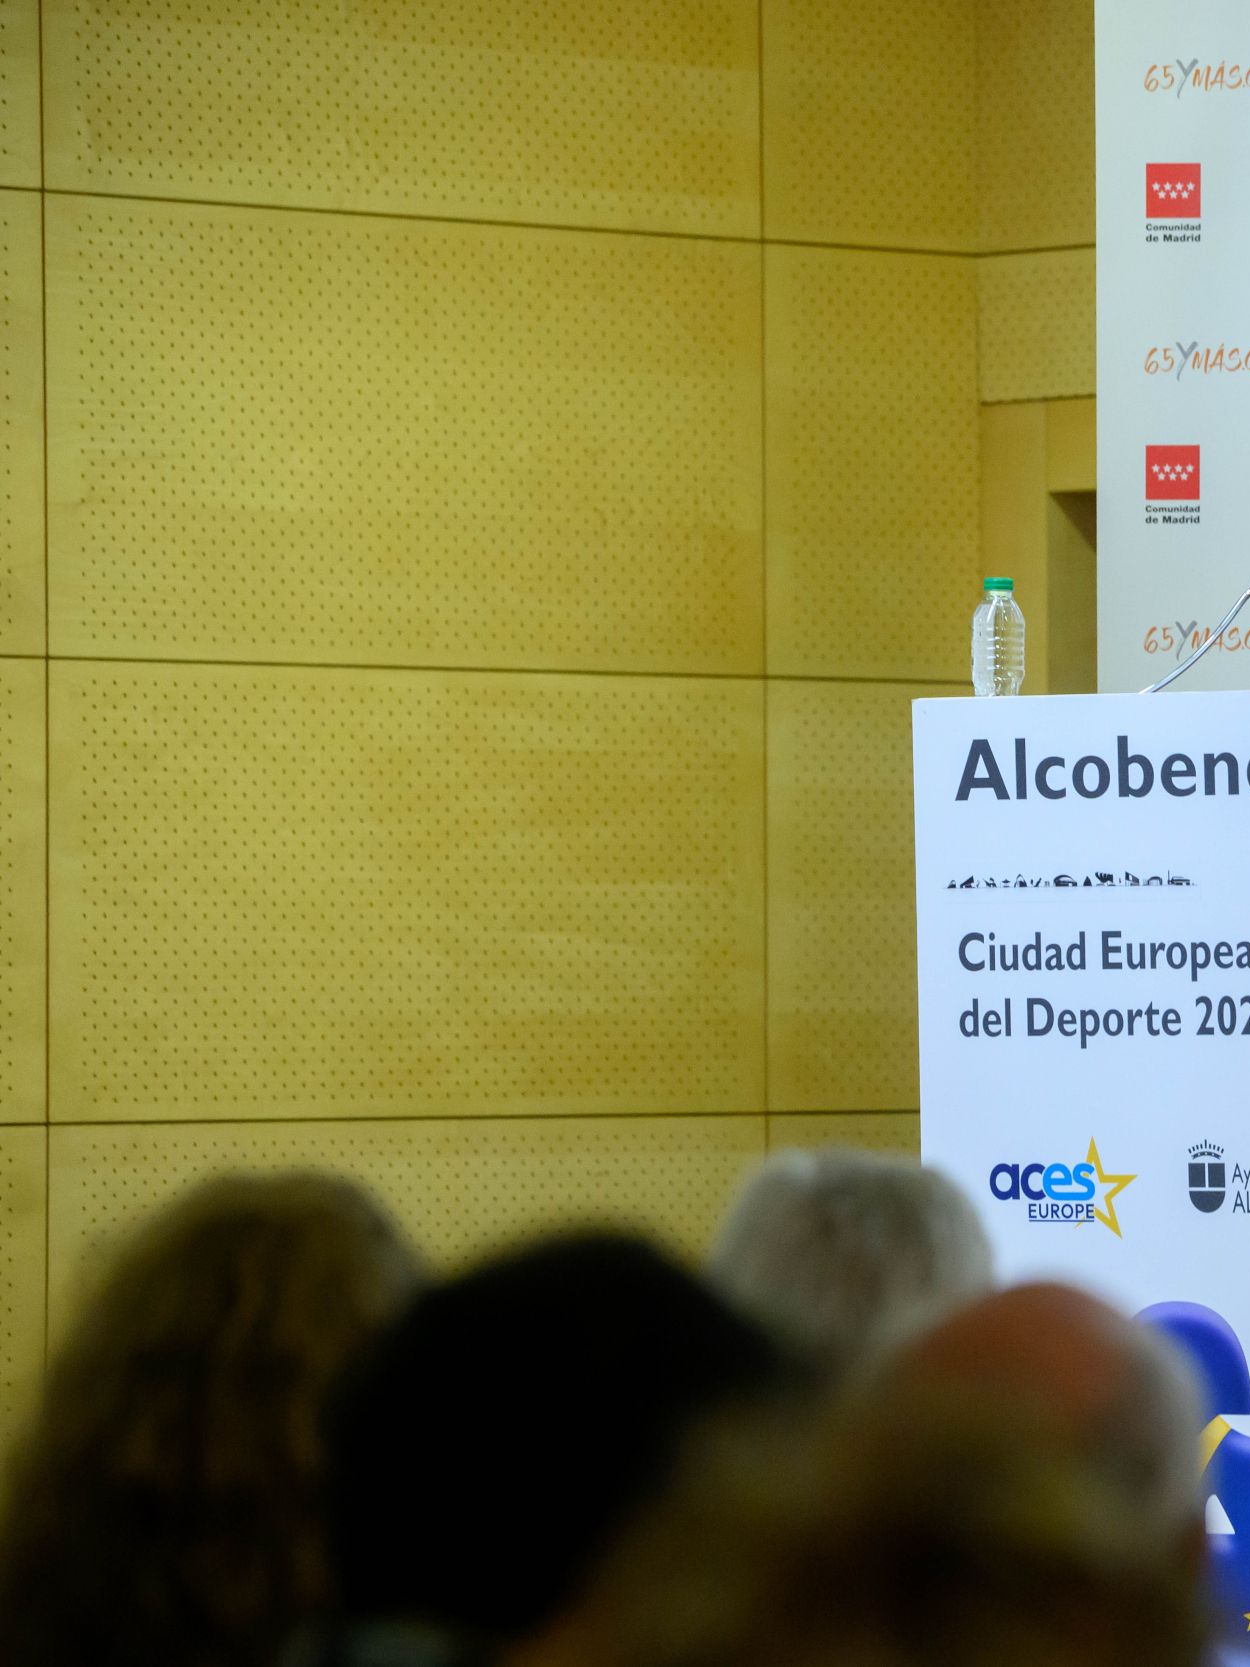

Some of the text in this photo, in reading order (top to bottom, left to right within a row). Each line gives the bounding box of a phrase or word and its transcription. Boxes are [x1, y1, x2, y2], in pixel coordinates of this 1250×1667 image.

[1145, 223, 1202, 232] Comunidad
[1145, 234, 1202, 243] de Madrid
[1145, 505, 1201, 513] Comunidad
[1145, 515, 1201, 524] de Madrid
[958, 931, 1086, 972] Ciudad
[959, 998, 1011, 1037] del
[1027, 997, 1182, 1049] Deporte
[989, 1162, 1095, 1201] aces
[1028, 1203, 1095, 1219] EUROPE
